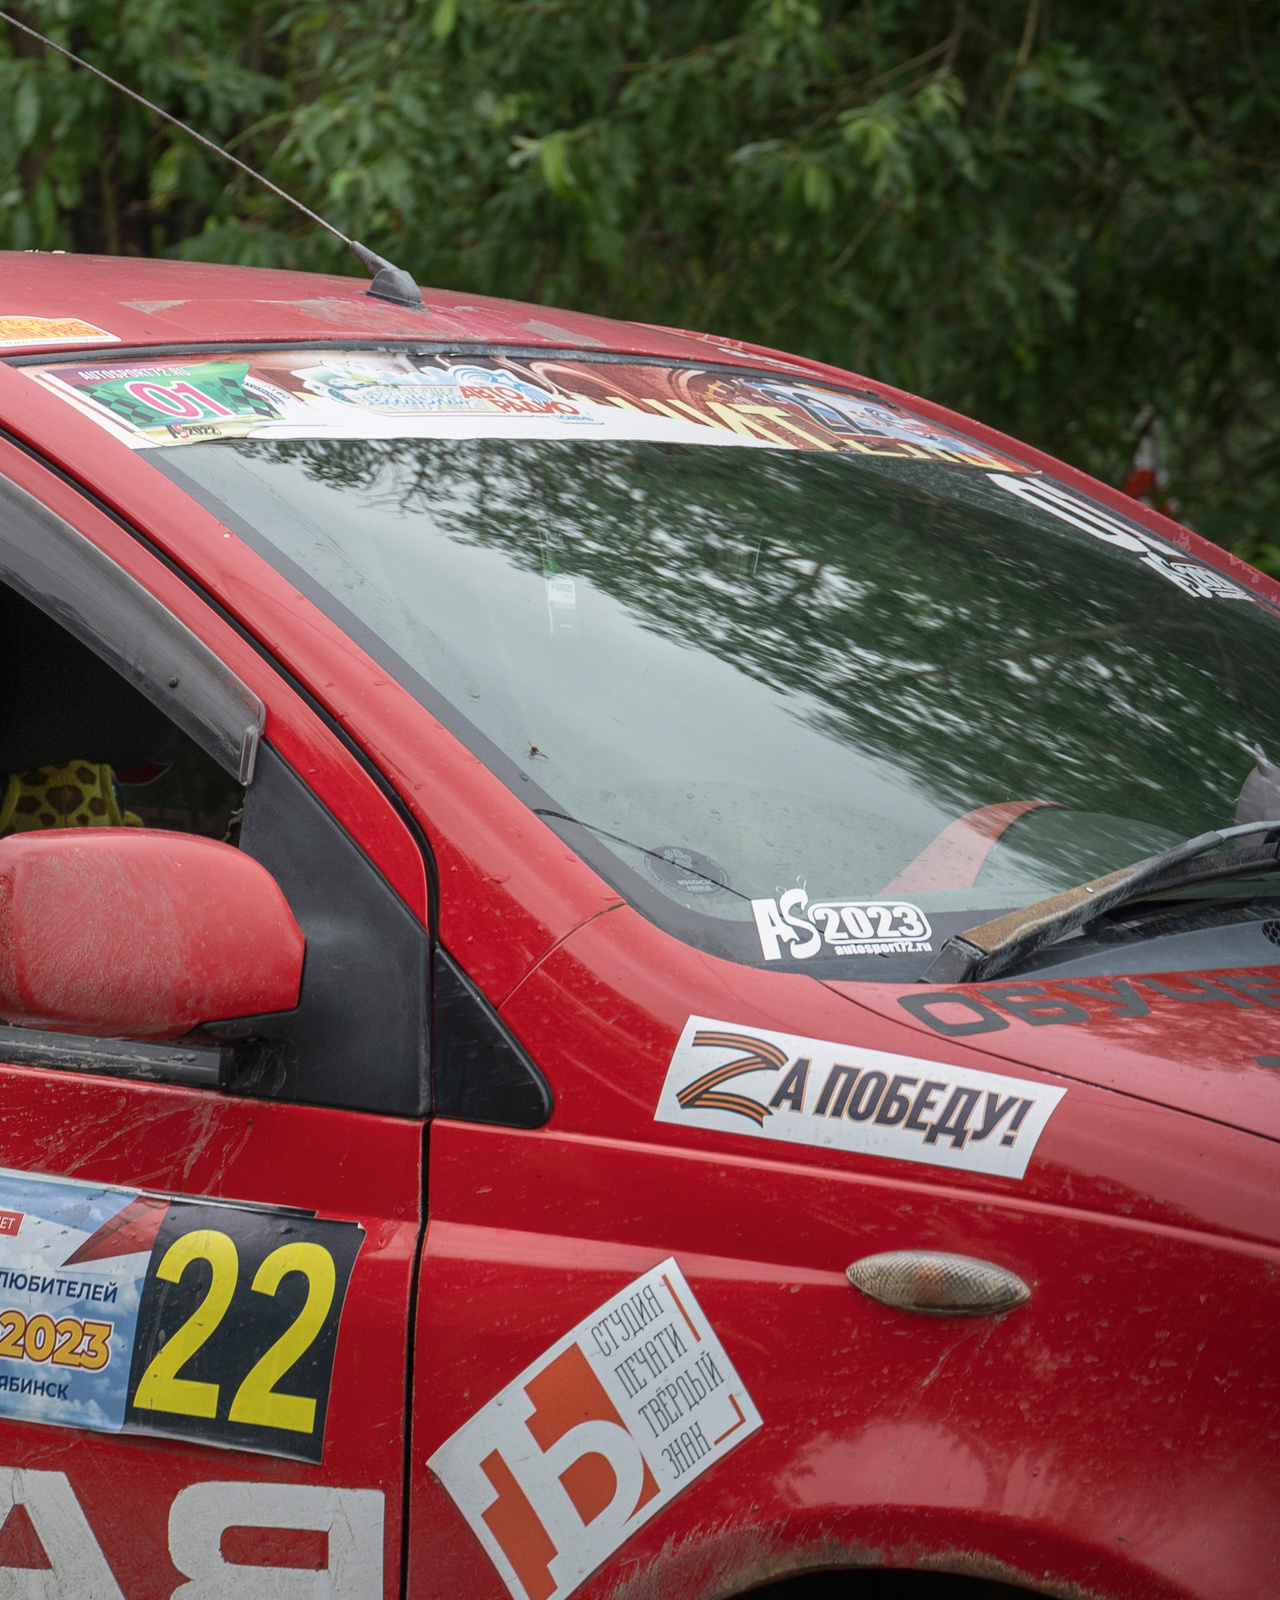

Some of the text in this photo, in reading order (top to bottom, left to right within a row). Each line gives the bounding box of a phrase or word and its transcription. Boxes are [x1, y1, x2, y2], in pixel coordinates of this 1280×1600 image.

[77, 366, 192, 382] AUTOSPORT72.RU
[124, 380, 234, 419] 01
[460, 385, 524, 400] АВТО
[488, 399, 581, 415] РАДИО
[751, 888, 924, 961] AS 2023
[834, 941, 933, 956] autosport72.ru
[815, 1062, 1036, 1151] ПОБЕДУ!
[133, 1229, 339, 1435] 22
[590, 1284, 665, 1358] СТУДИЯ
[613, 1322, 689, 1400] ПЕЧАТИ
[638, 1350, 726, 1439] ТВЁРДЫЙ
[660, 1421, 713, 1480] ЗНАК
